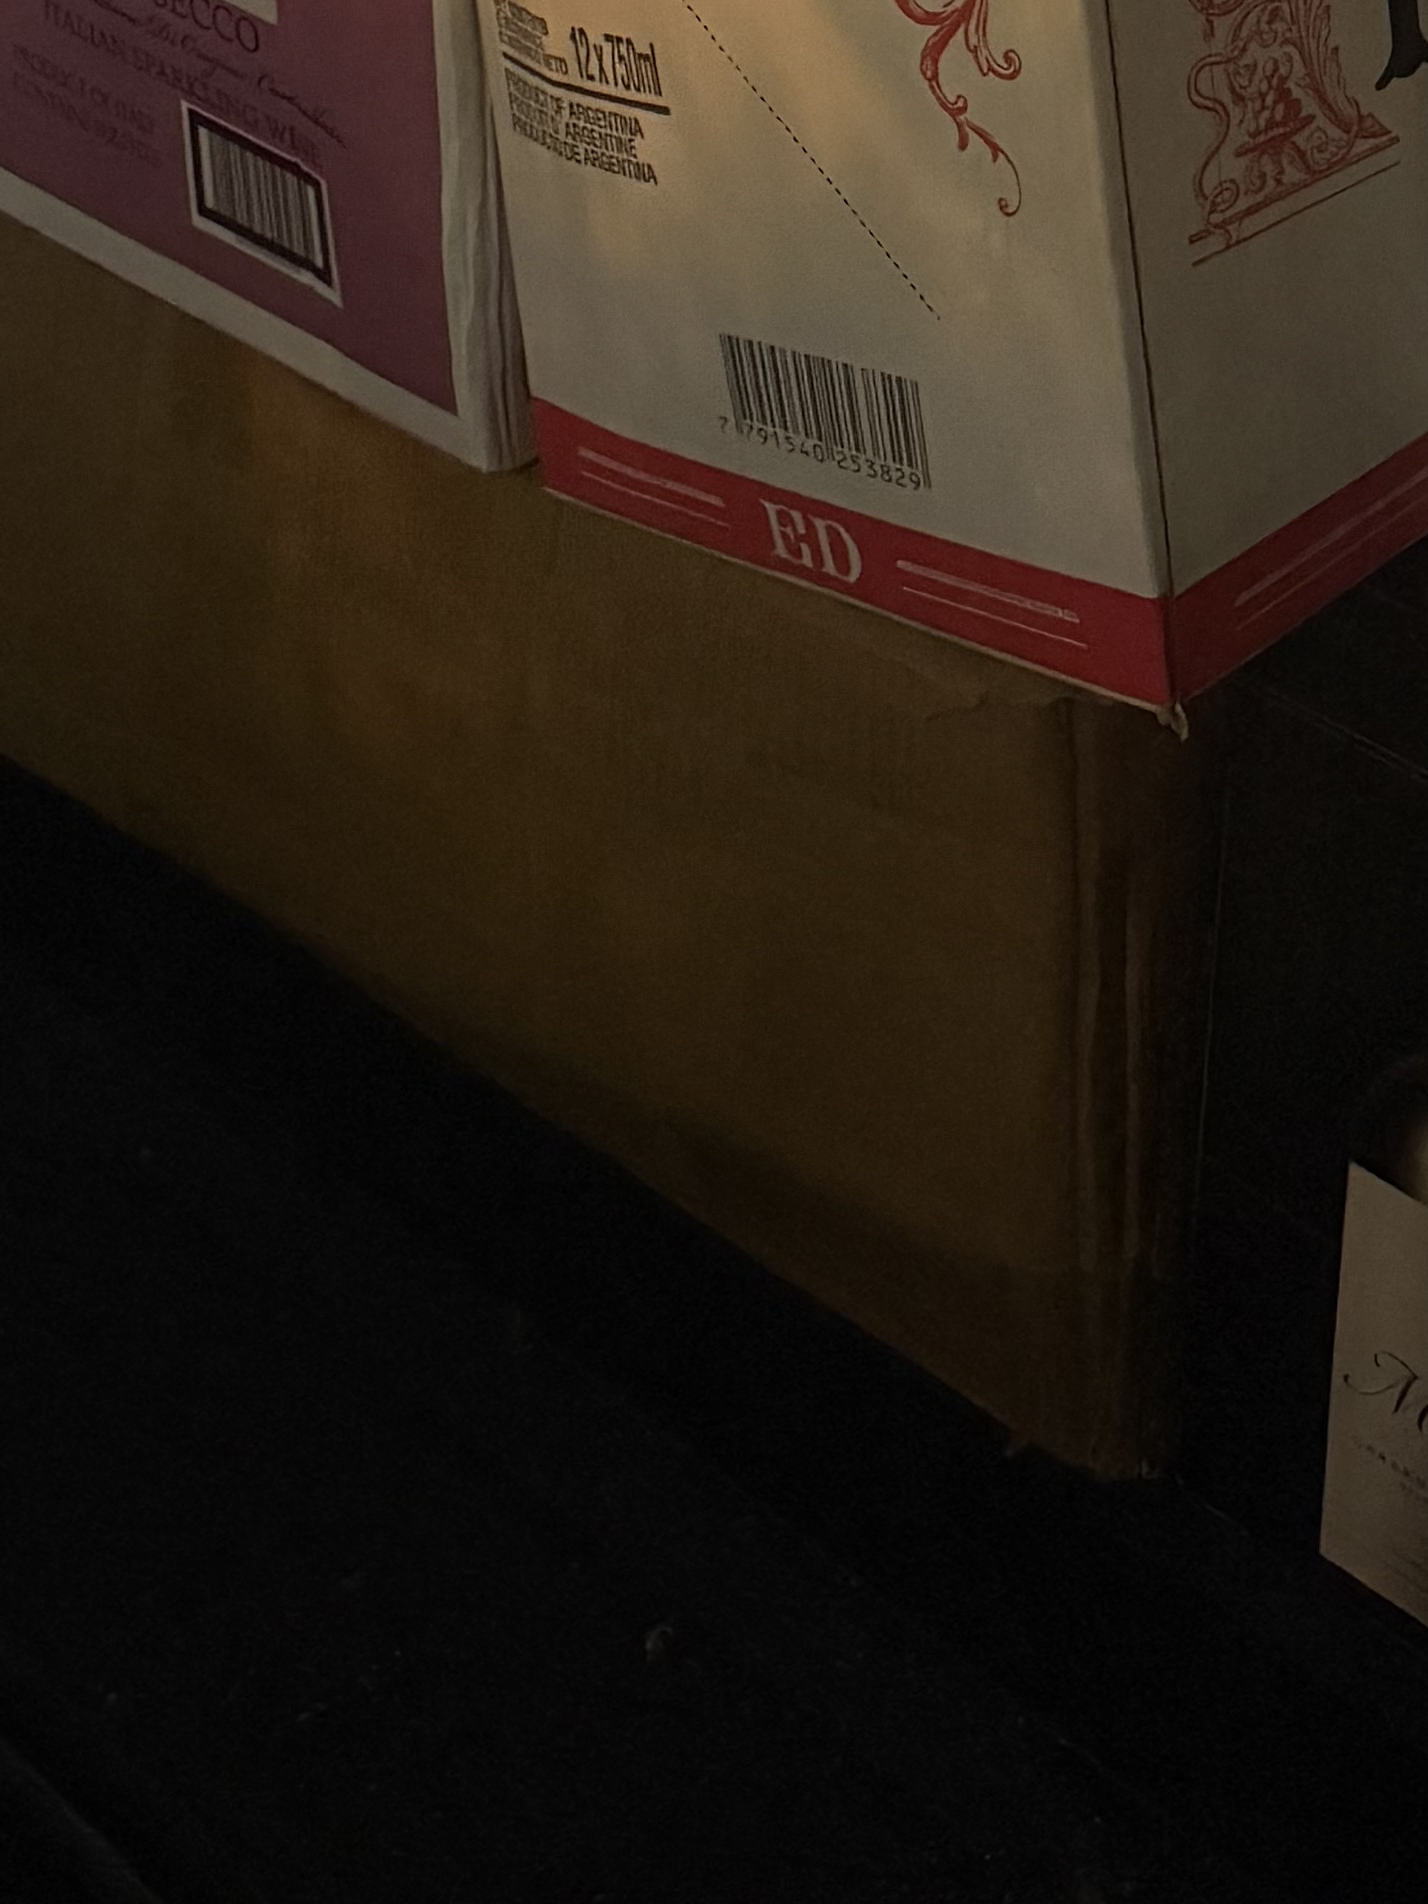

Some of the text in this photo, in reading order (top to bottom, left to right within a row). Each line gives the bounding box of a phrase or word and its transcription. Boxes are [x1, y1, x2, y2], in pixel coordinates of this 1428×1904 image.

[569, 25, 597, 82] 12
[603, 32, 663, 97] 750ml
[568, 101, 645, 141] ARGENTINA
[582, 145, 659, 187] ARGENTINA
[747, 425, 827, 464] 791540
[836, 449, 923, 491] 253829
[757, 497, 864, 585] ED
